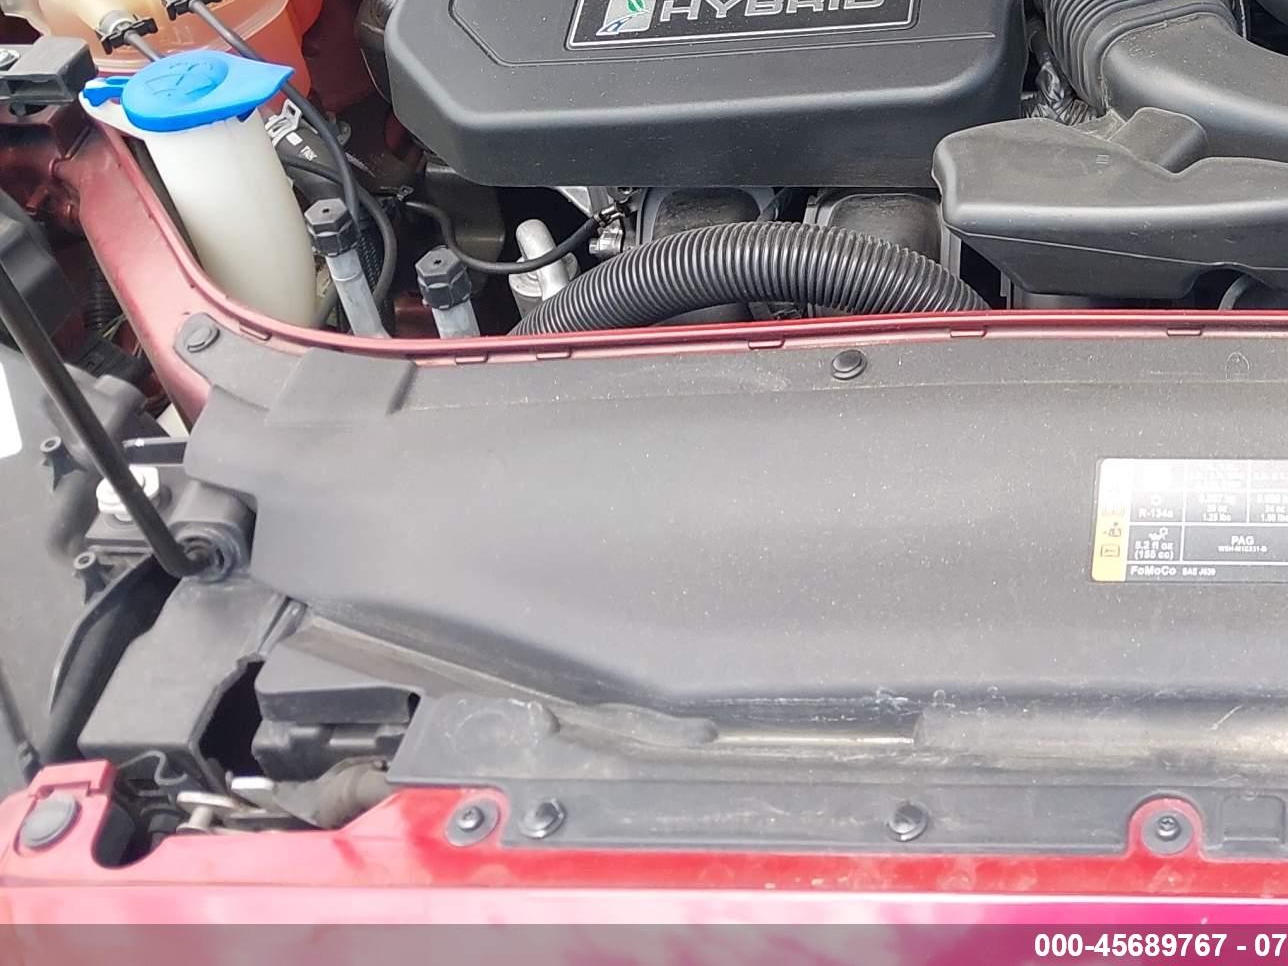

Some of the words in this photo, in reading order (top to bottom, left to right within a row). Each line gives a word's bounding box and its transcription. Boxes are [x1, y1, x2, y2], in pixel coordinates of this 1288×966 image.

[1138, 507, 1174, 519] R-134a
[1231, 535, 1255, 546] PAG
[1130, 565, 1177, 576] FoMoCo
[1182, 565, 1198, 576] SAE
